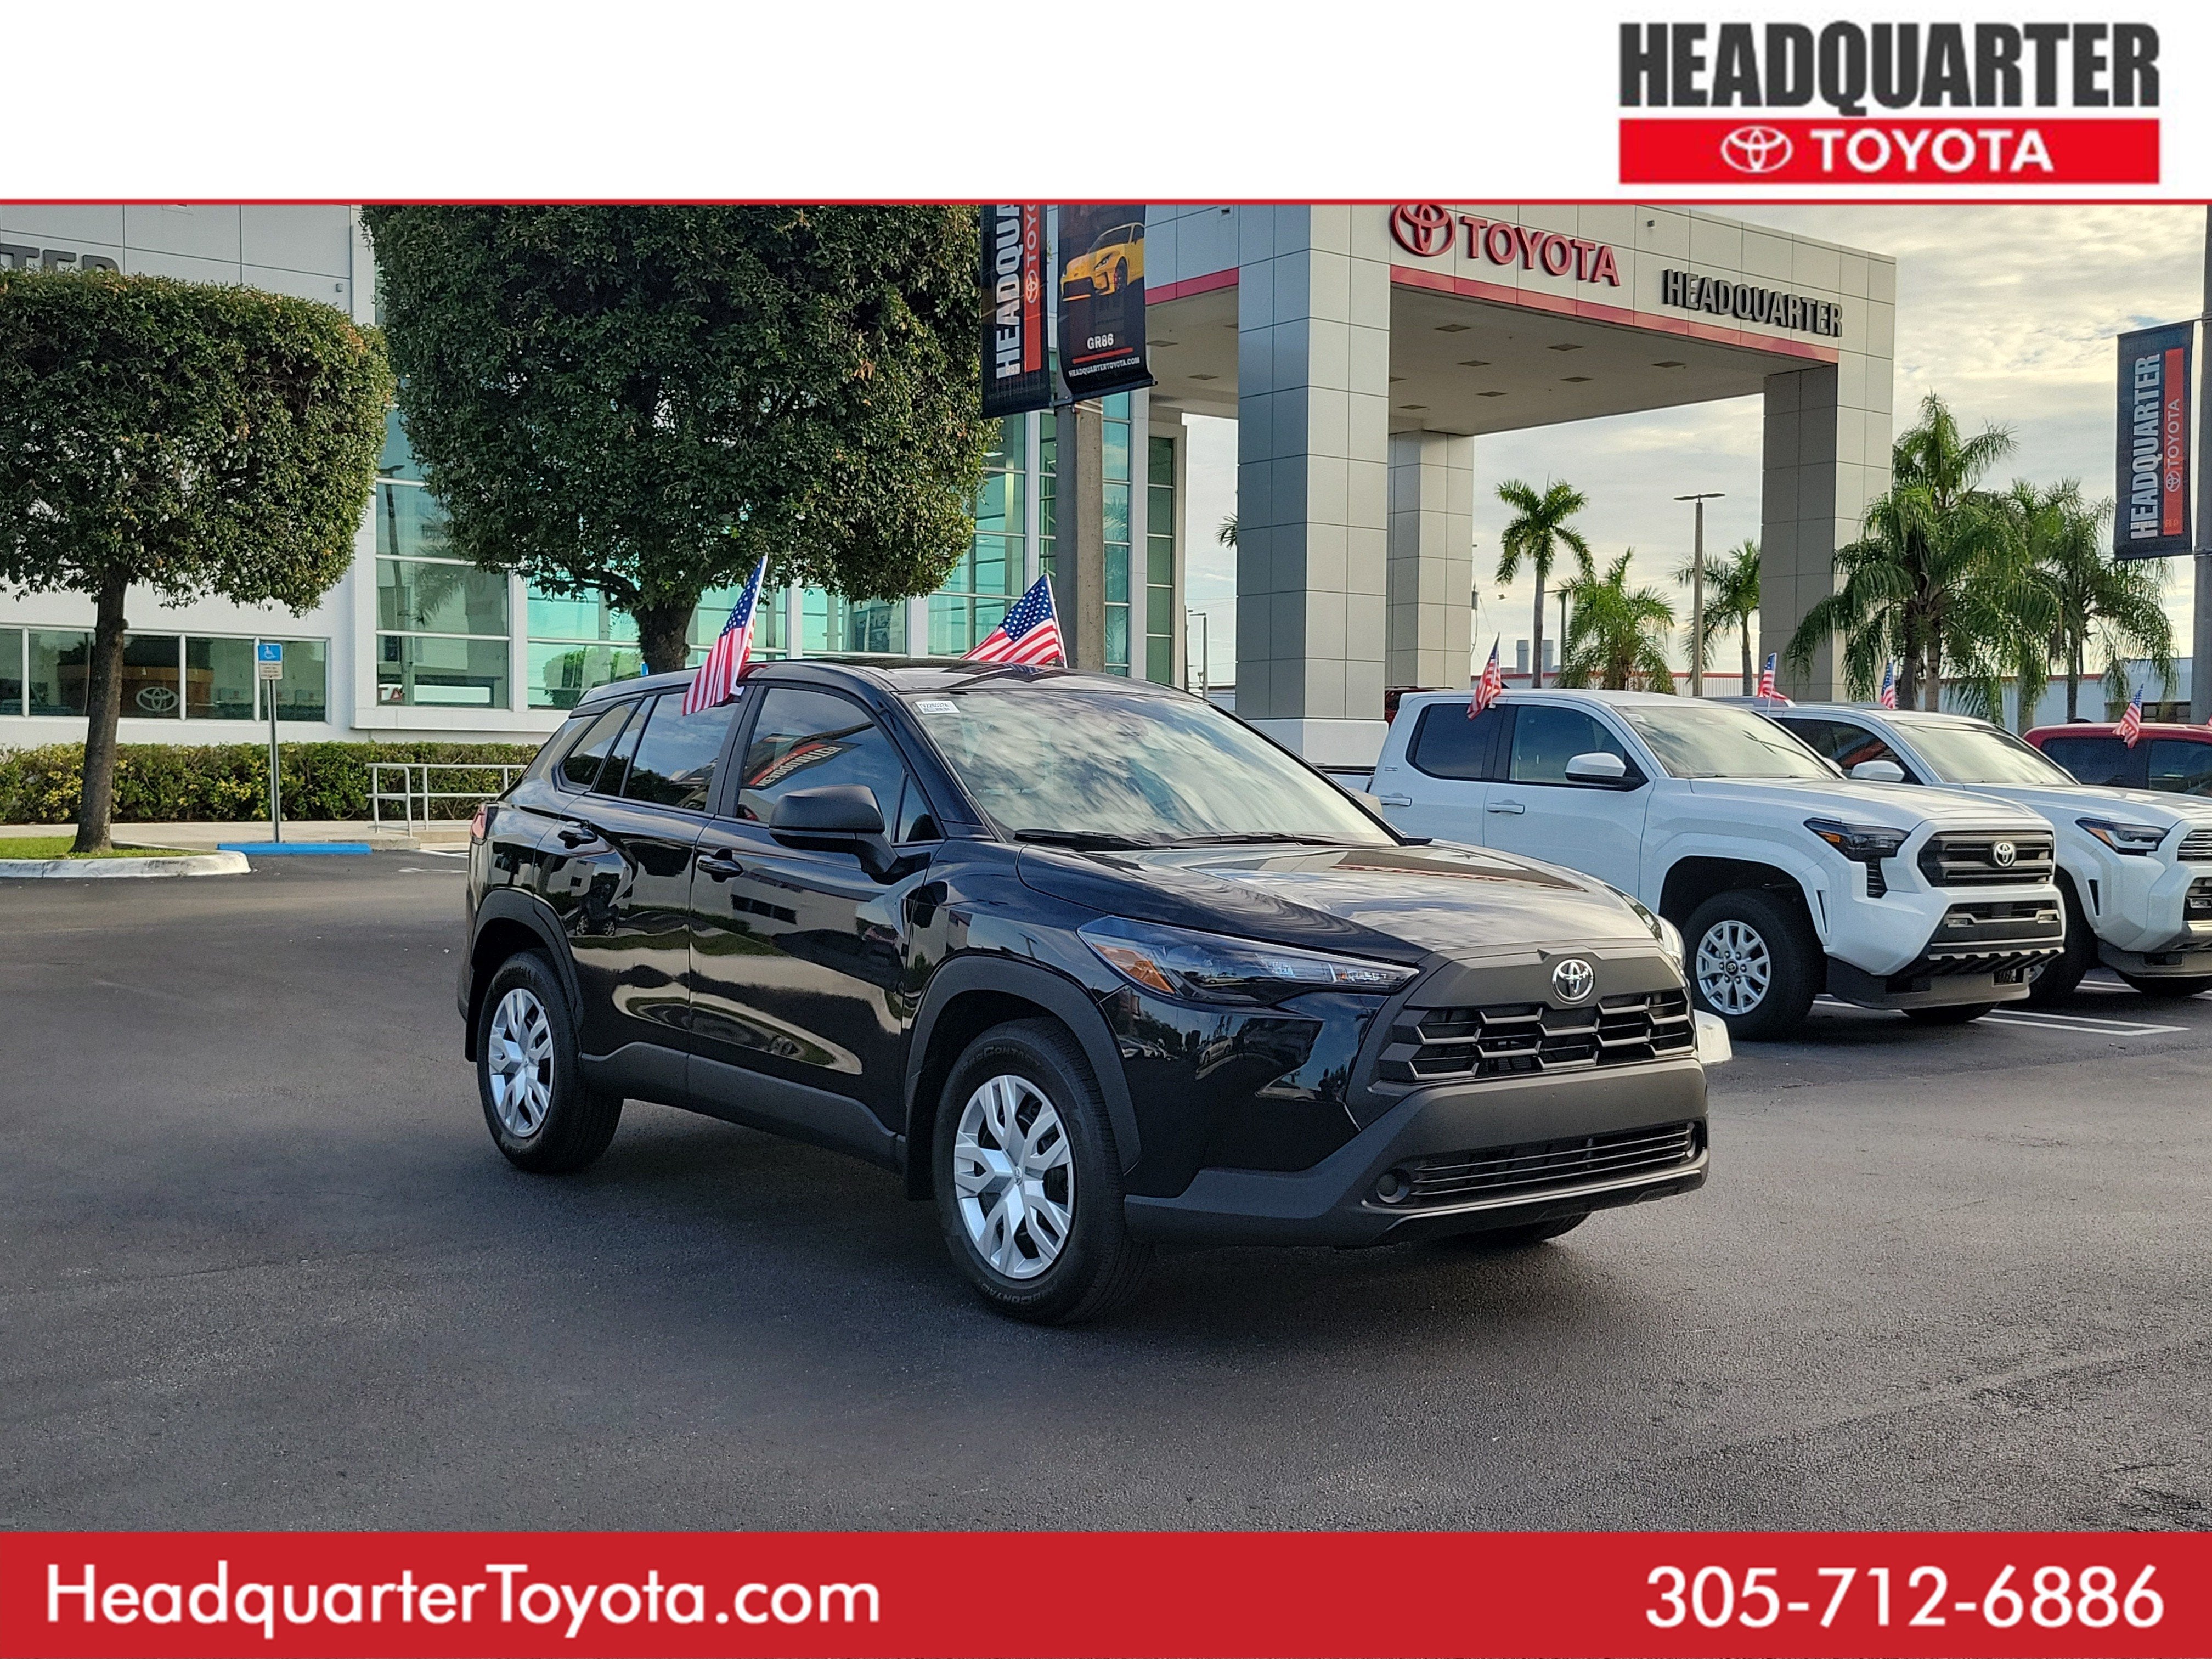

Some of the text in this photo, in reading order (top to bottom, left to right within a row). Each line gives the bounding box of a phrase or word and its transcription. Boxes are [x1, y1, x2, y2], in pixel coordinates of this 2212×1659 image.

[1459, 215, 1621, 286] TOYOTA
[1662, 269, 1843, 337] HEADQUARTER
[1068, 357, 1140, 377] HEADQUARTERTOYOTA.COM
[1087, 333, 1114, 350] GR86
[2130, 353, 2163, 539] HEADQUARTER
[2166, 398, 2180, 469] TOYOTA
